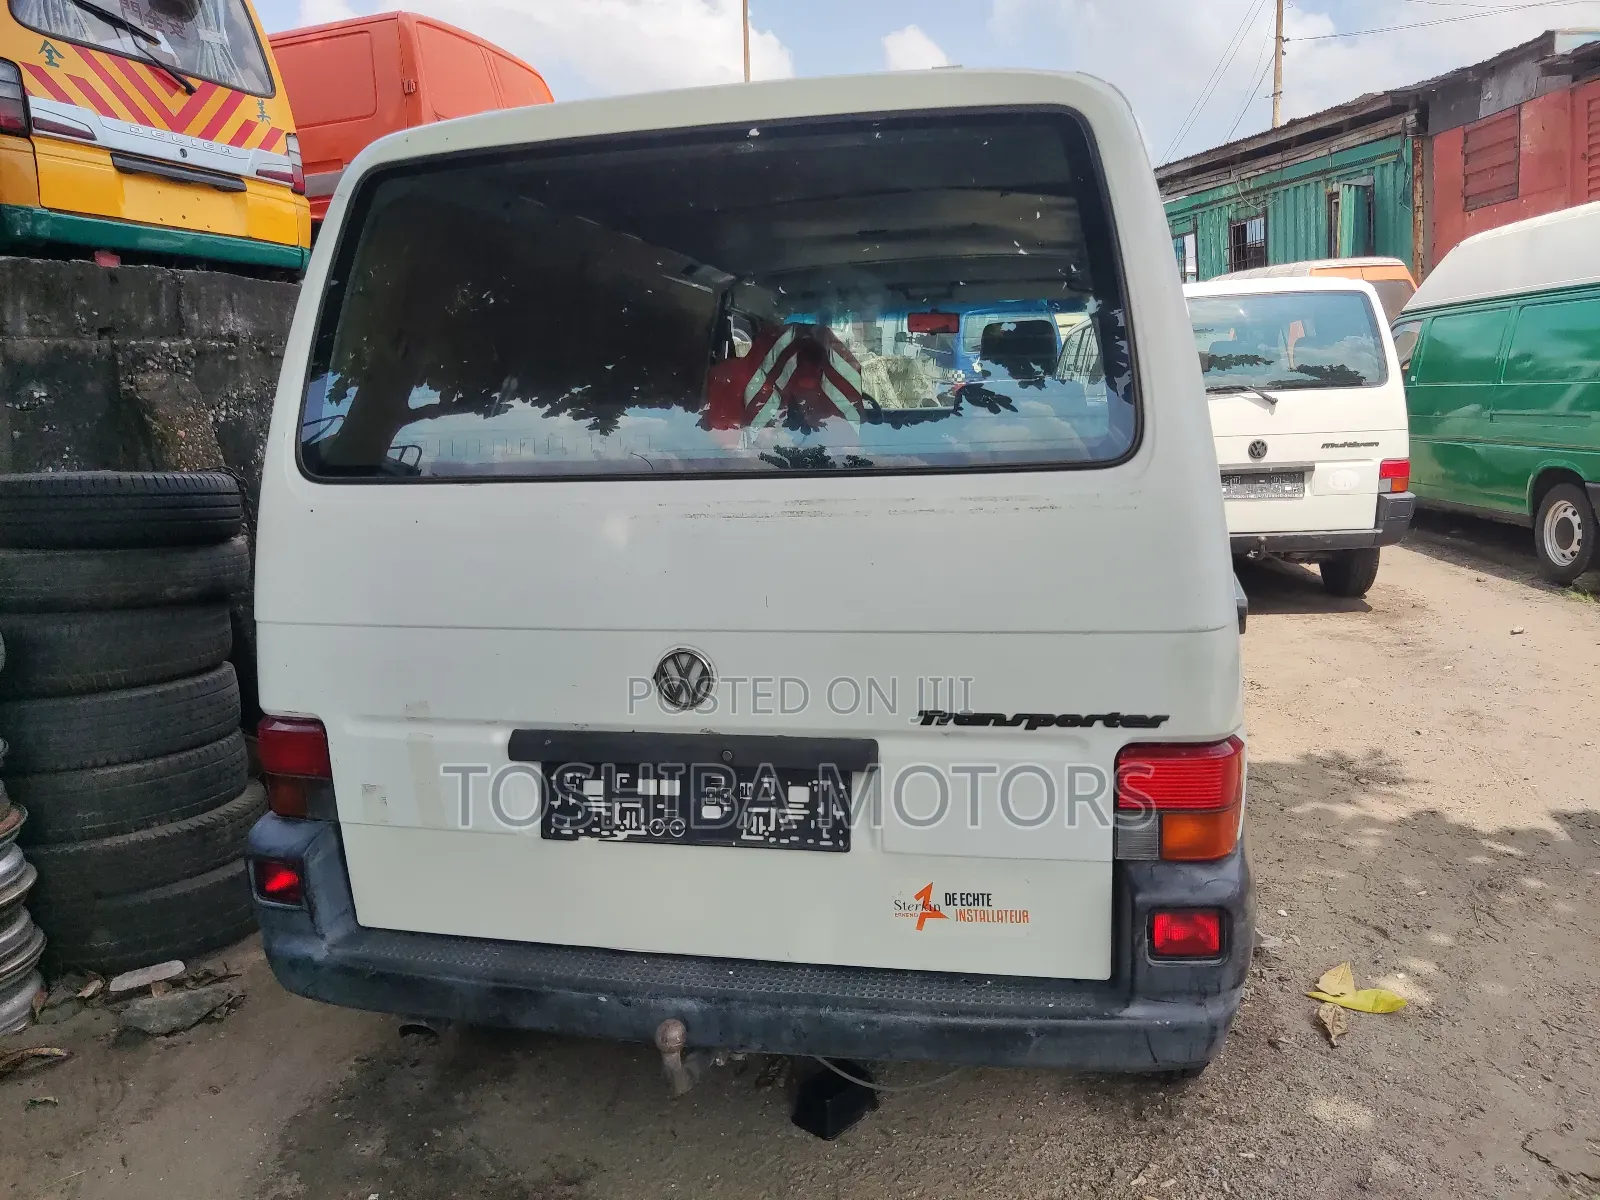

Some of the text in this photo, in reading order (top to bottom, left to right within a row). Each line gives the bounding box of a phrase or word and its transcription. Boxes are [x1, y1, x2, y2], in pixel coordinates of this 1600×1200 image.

[918, 709, 1171, 731] Transporter
[893, 899, 941, 912] Sterkin
[944, 892, 993, 907] DE ECHTE
[955, 908, 1030, 924] INSTALLATEUR
